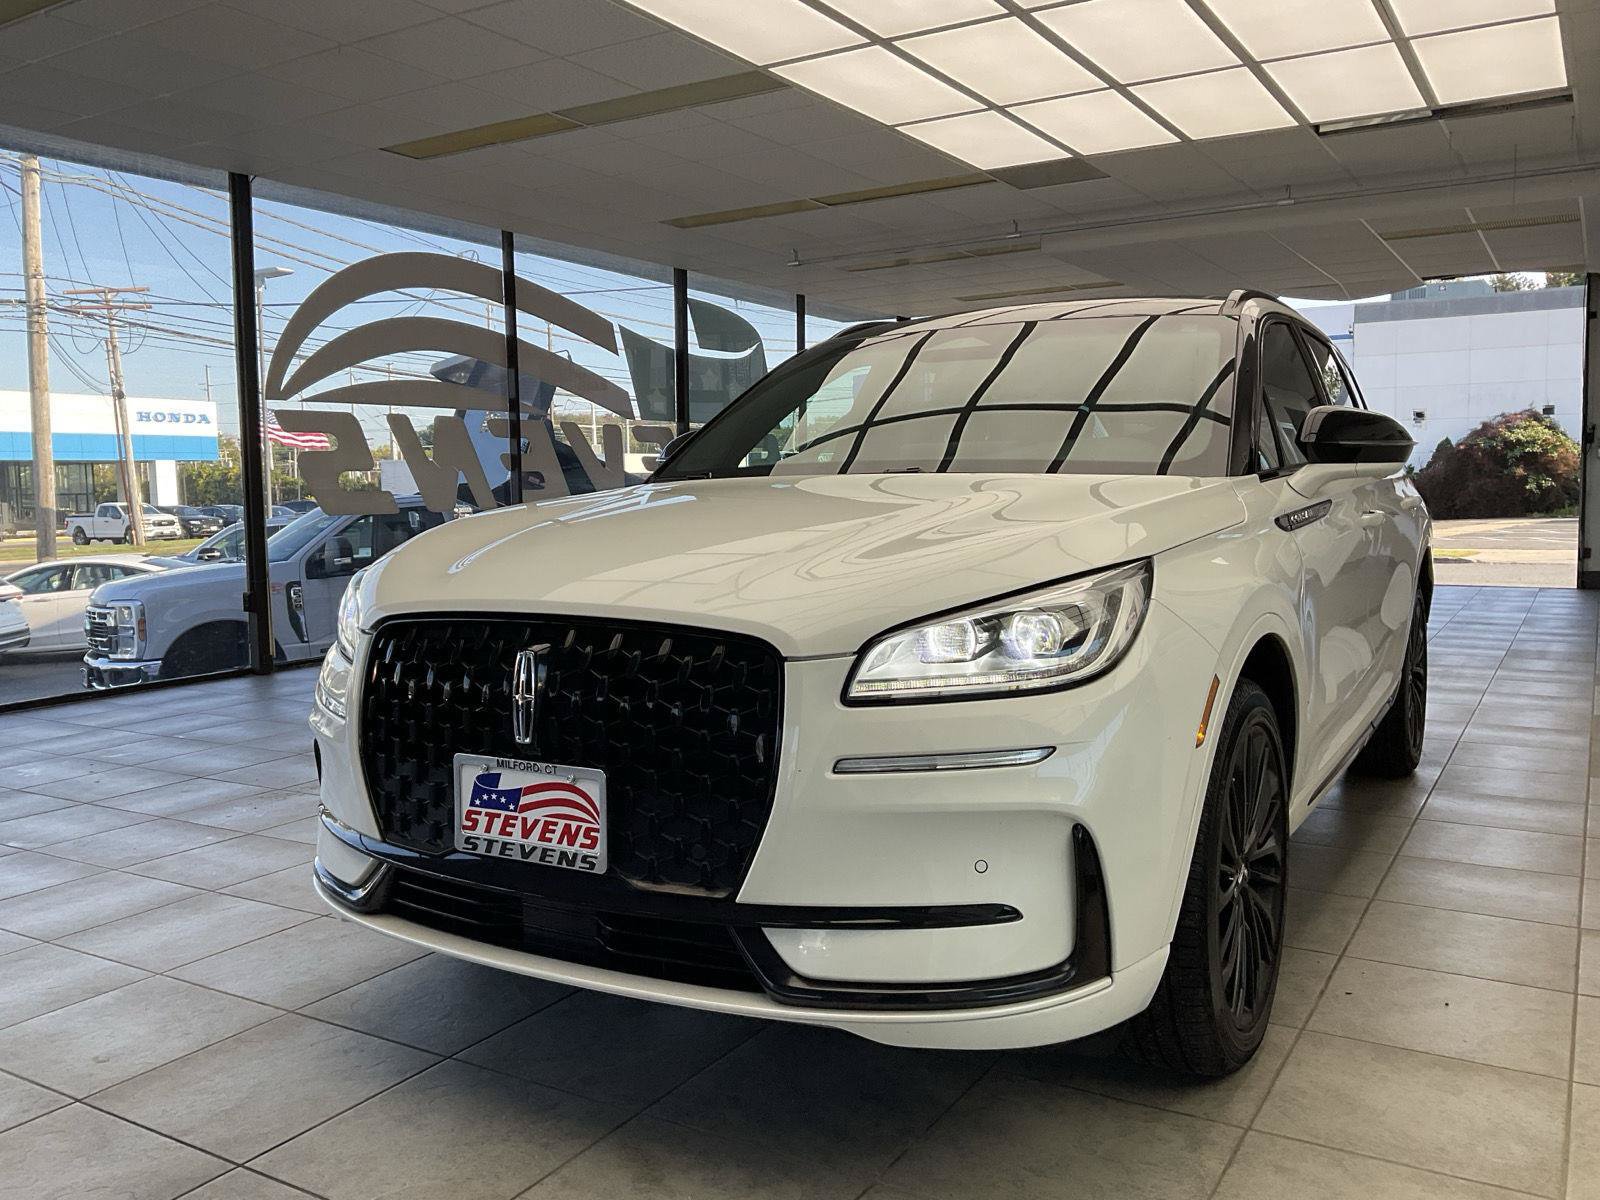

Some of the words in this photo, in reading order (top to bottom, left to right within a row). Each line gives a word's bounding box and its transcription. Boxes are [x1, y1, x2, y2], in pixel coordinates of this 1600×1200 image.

[136, 411, 211, 424] HONDA
[545, 764, 557, 775] CT
[462, 809, 600, 850] STEVENS
[462, 836, 598, 871] STEVENS
